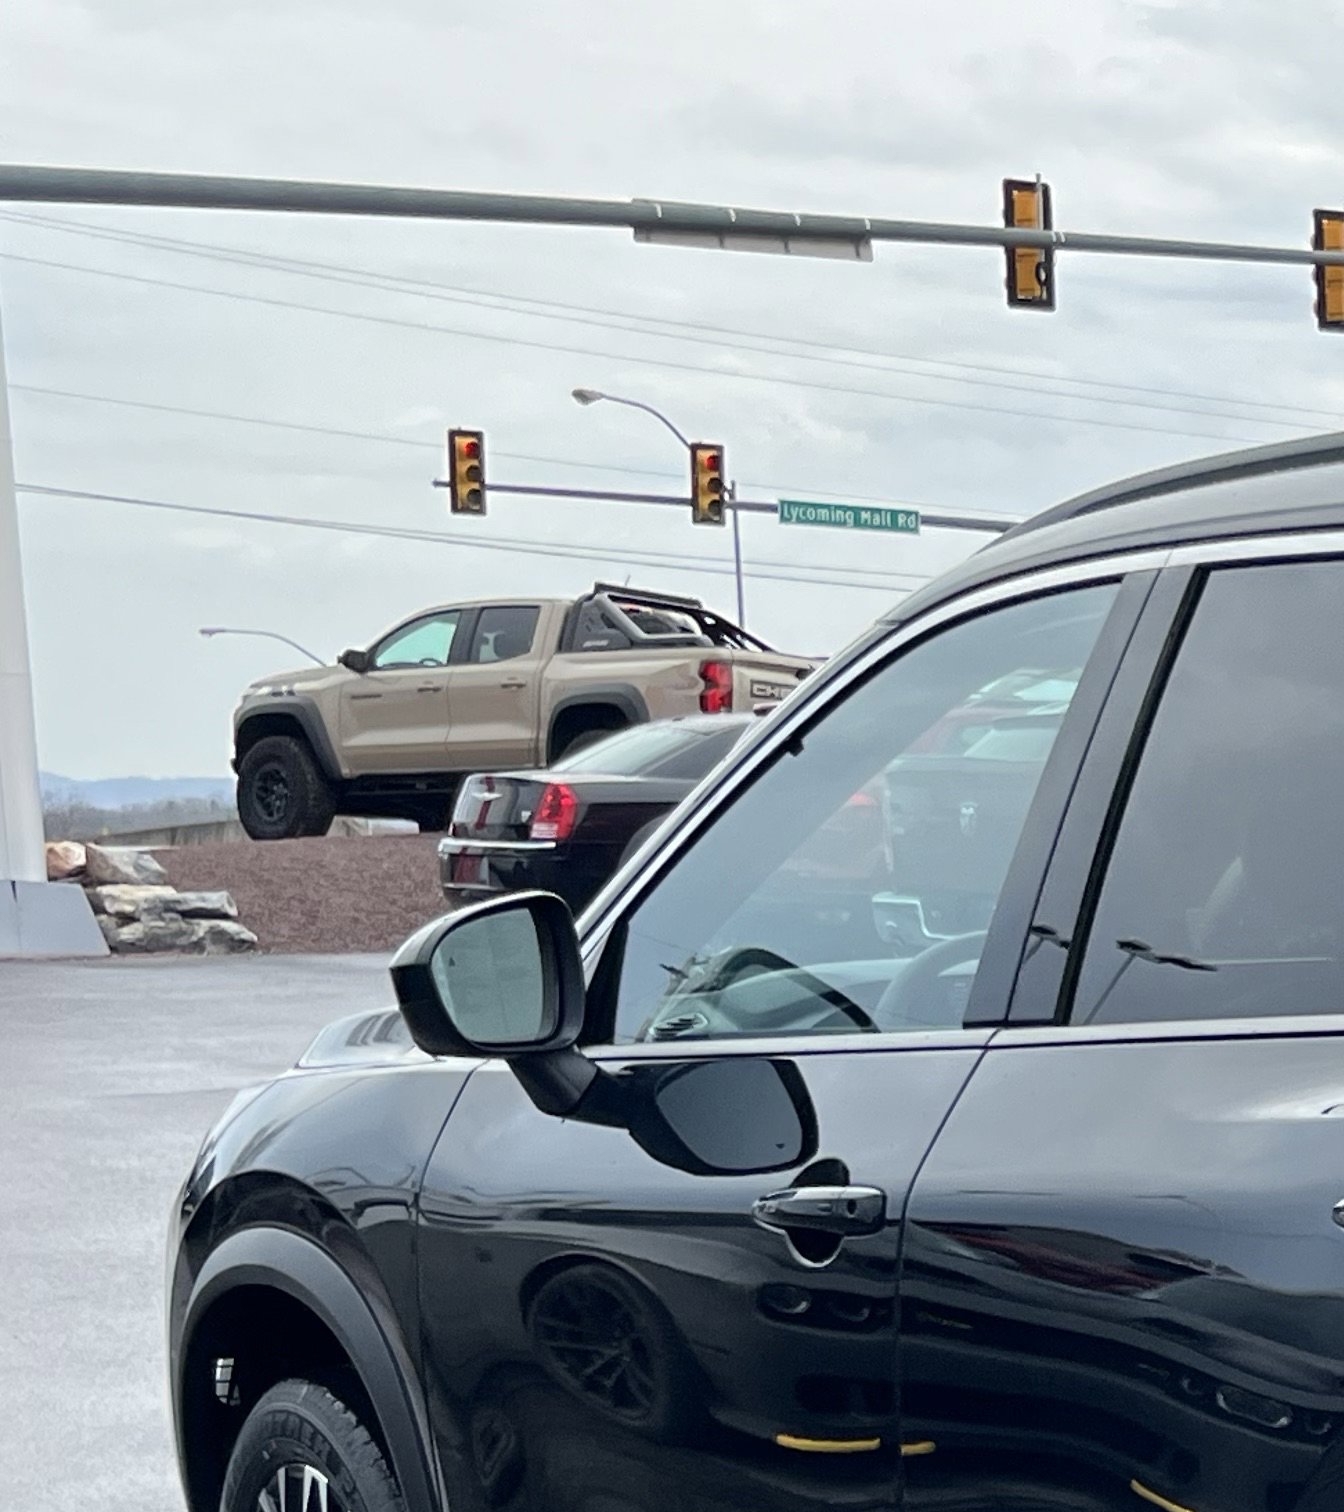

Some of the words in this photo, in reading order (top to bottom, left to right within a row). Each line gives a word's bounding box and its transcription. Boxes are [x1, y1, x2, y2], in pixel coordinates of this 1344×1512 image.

[783, 504, 854, 527] Lycoming
[860, 511, 892, 527] Mall
[898, 513, 917, 528] Rd
